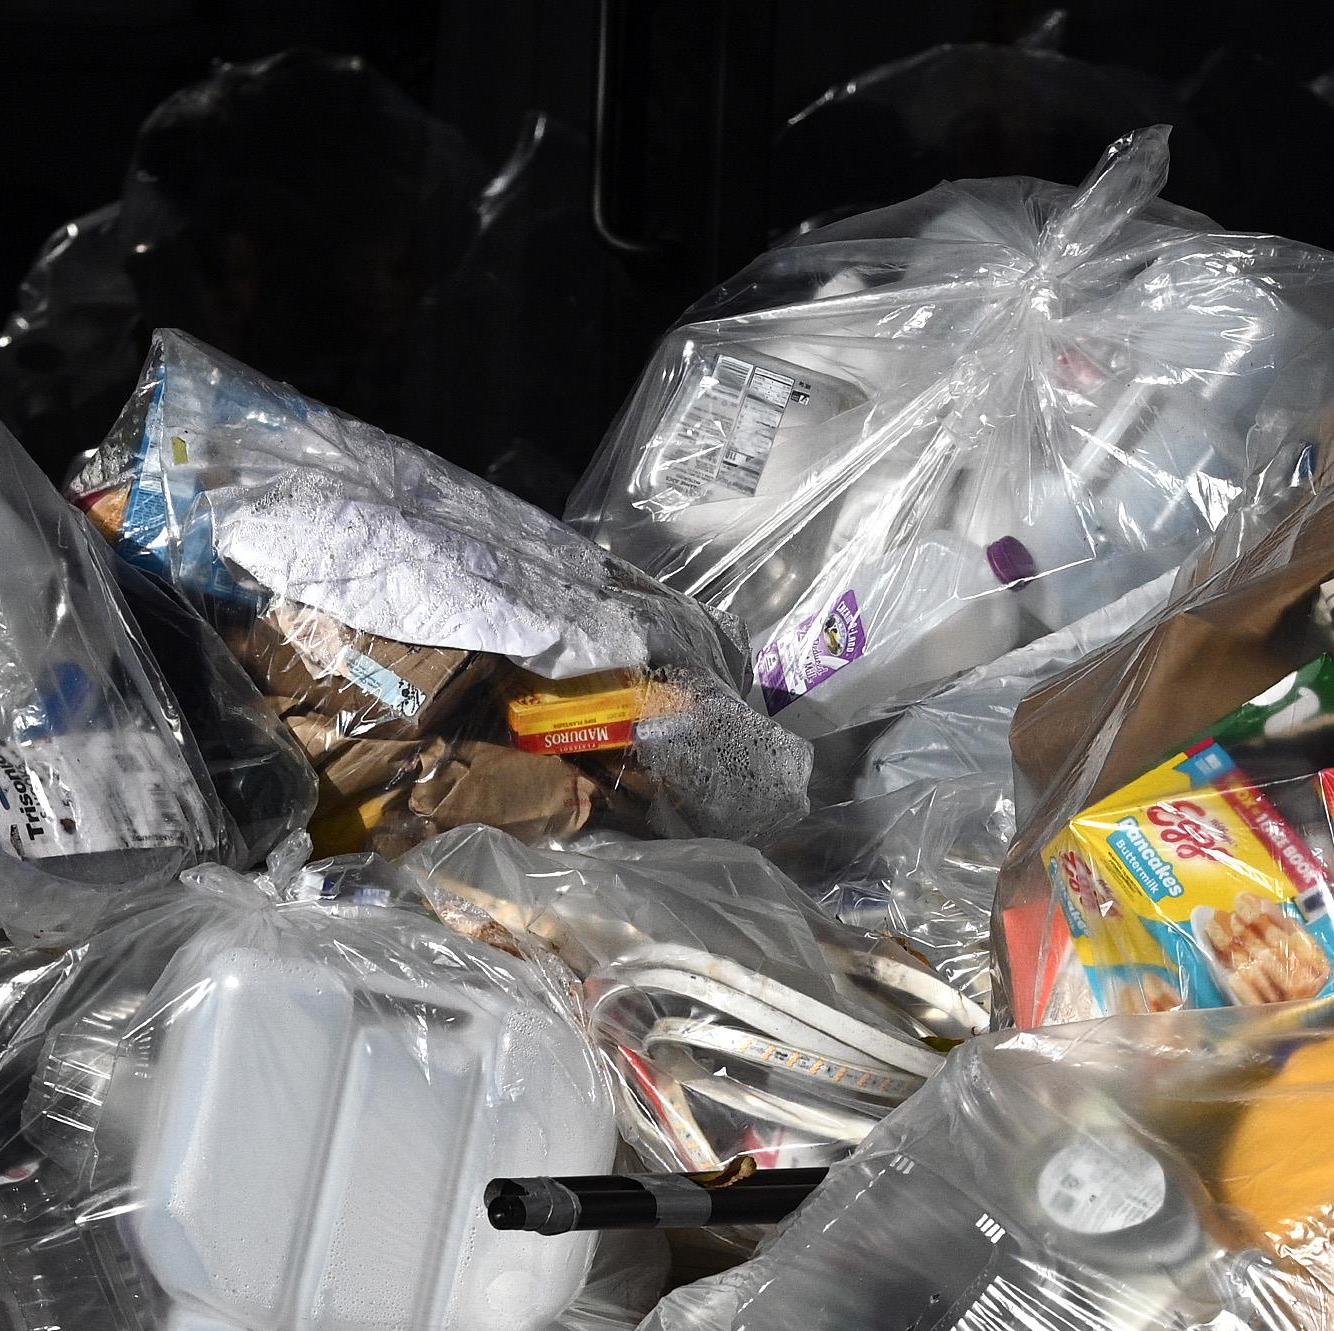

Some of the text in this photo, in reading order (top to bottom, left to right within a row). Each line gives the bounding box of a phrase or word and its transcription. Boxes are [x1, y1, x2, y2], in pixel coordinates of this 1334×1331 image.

[544, 725, 609, 748] MADUROS
[1115, 840, 1159, 895] Buttermilk
[1118, 817, 1184, 899] Pancakes
